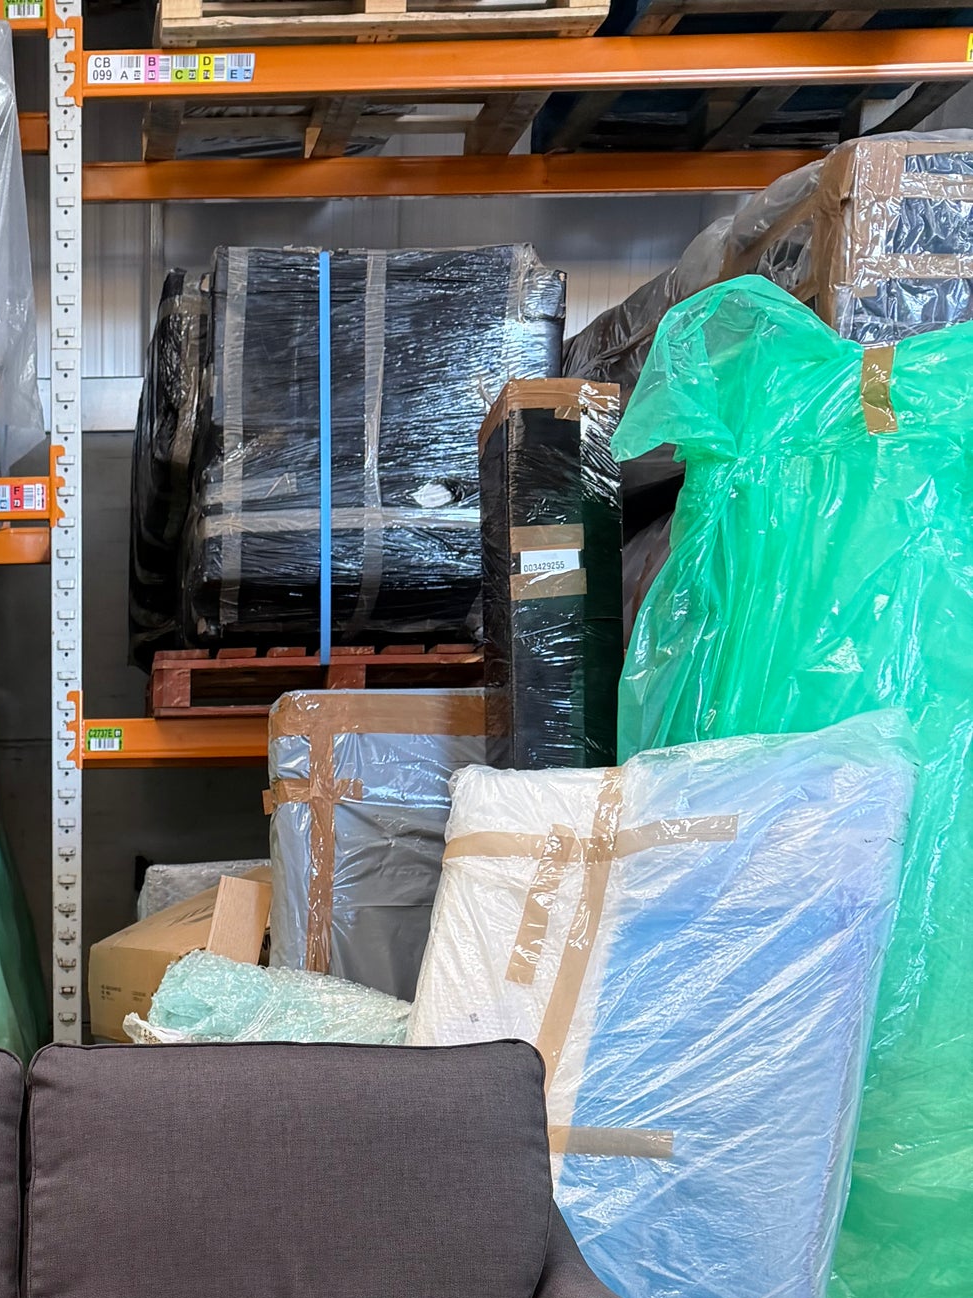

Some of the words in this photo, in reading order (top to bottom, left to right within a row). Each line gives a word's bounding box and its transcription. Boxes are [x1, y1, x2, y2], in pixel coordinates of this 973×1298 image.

[94, 57, 111, 68] CB
[148, 57, 156, 66] B
[203, 56, 211, 66] D
[92, 69, 112, 80] 099
[120, 70, 129, 80] A
[175, 69, 183, 80] C
[230, 69, 238, 79] E
[13, 486, 20, 495] F
